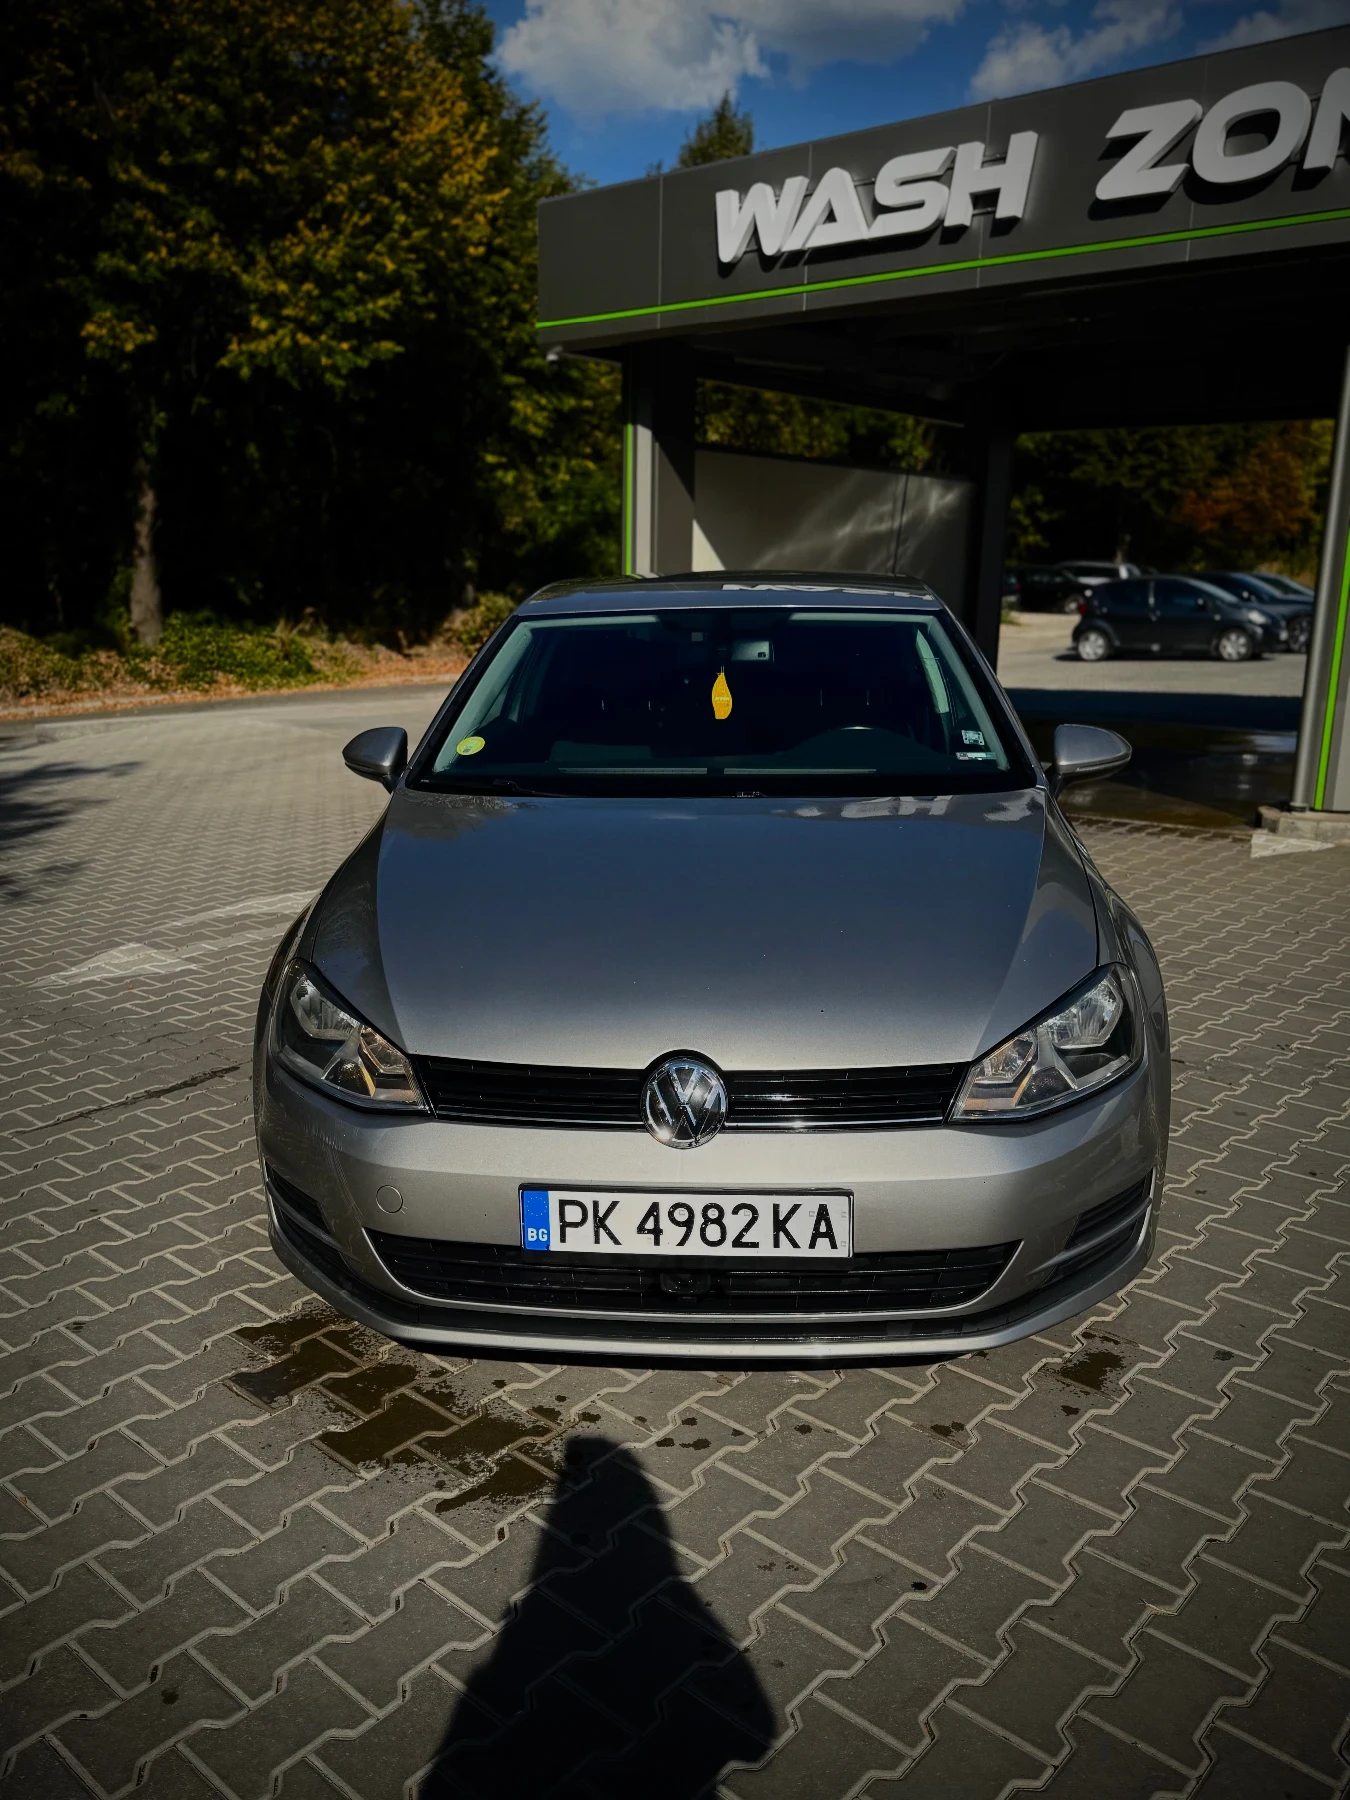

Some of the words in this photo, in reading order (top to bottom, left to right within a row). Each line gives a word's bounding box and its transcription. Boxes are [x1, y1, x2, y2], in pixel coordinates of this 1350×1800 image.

[716, 131, 1038, 263] WASH
[527, 1227, 548, 1242] BG
[558, 1199, 622, 1246] PK
[636, 1201, 760, 1249] 4982
[772, 1203, 839, 1250] KA
